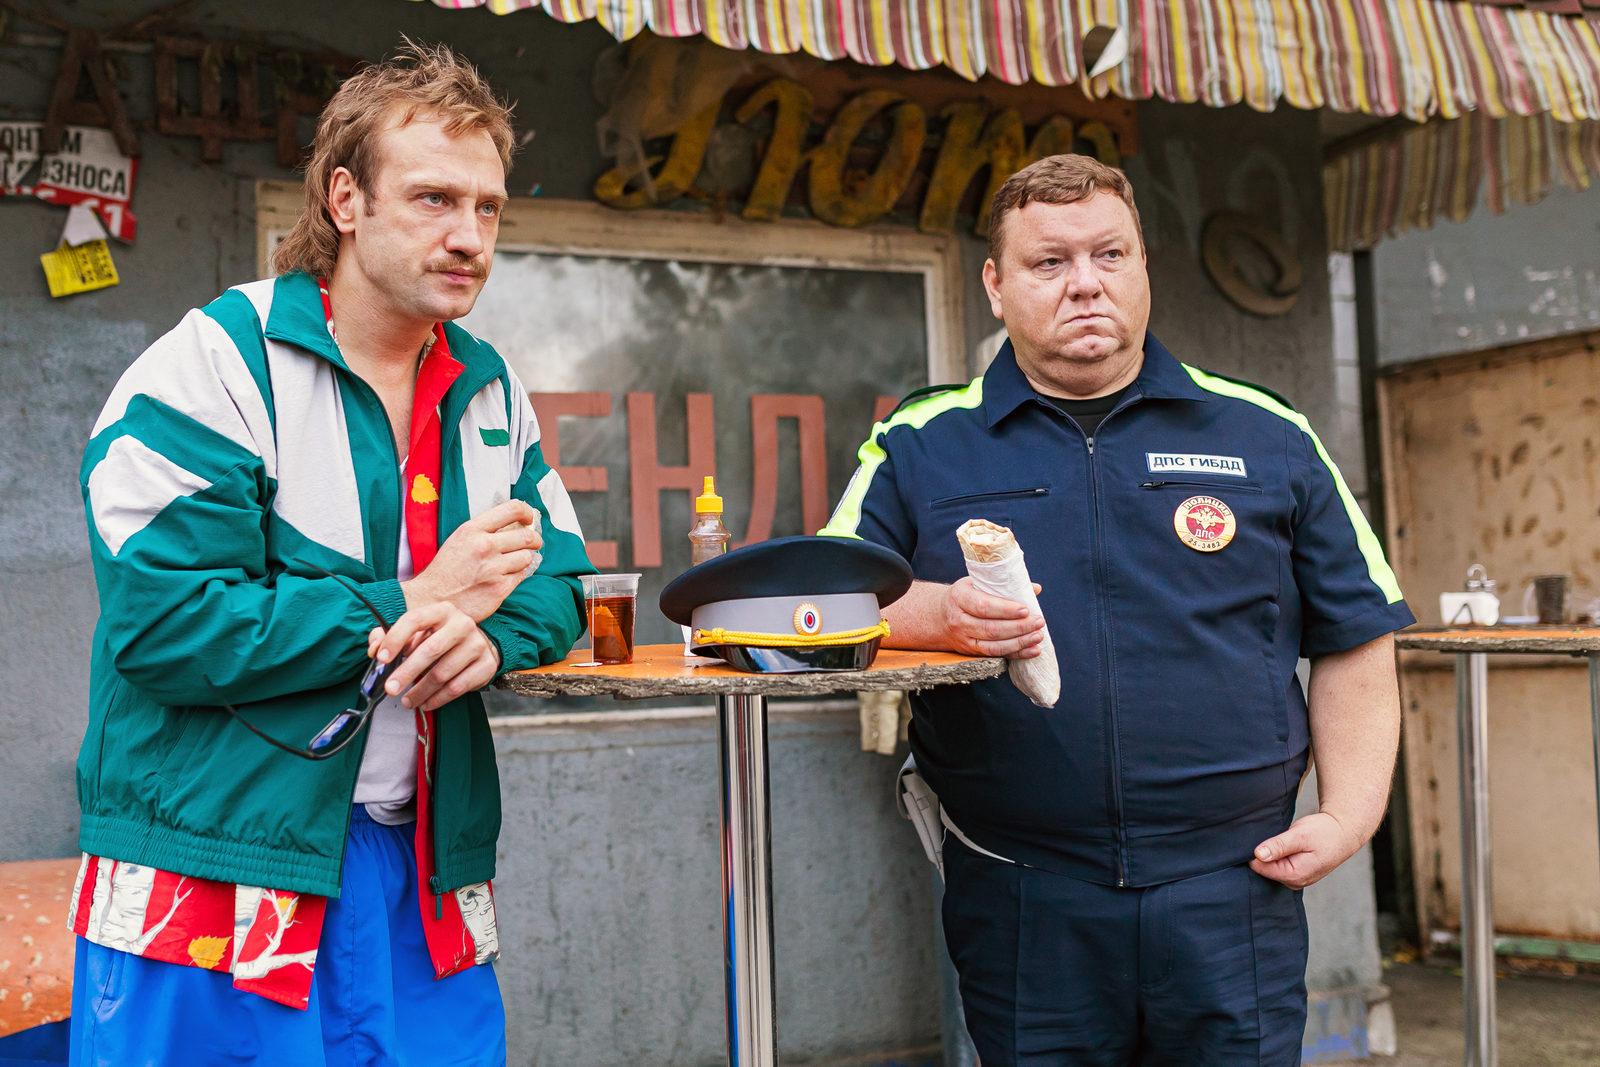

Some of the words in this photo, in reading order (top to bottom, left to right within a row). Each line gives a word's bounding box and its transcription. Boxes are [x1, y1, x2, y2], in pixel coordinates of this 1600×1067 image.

[43, 158, 127, 196] ЗНОСА
[1153, 456, 1186, 468] ДПС
[1189, 457, 1242, 472] ГИБДД
[530, 391, 900, 568] ЕНД
[1184, 497, 1232, 517] ПОЛИЦИЯ
[1194, 528, 1215, 540] ДПС
